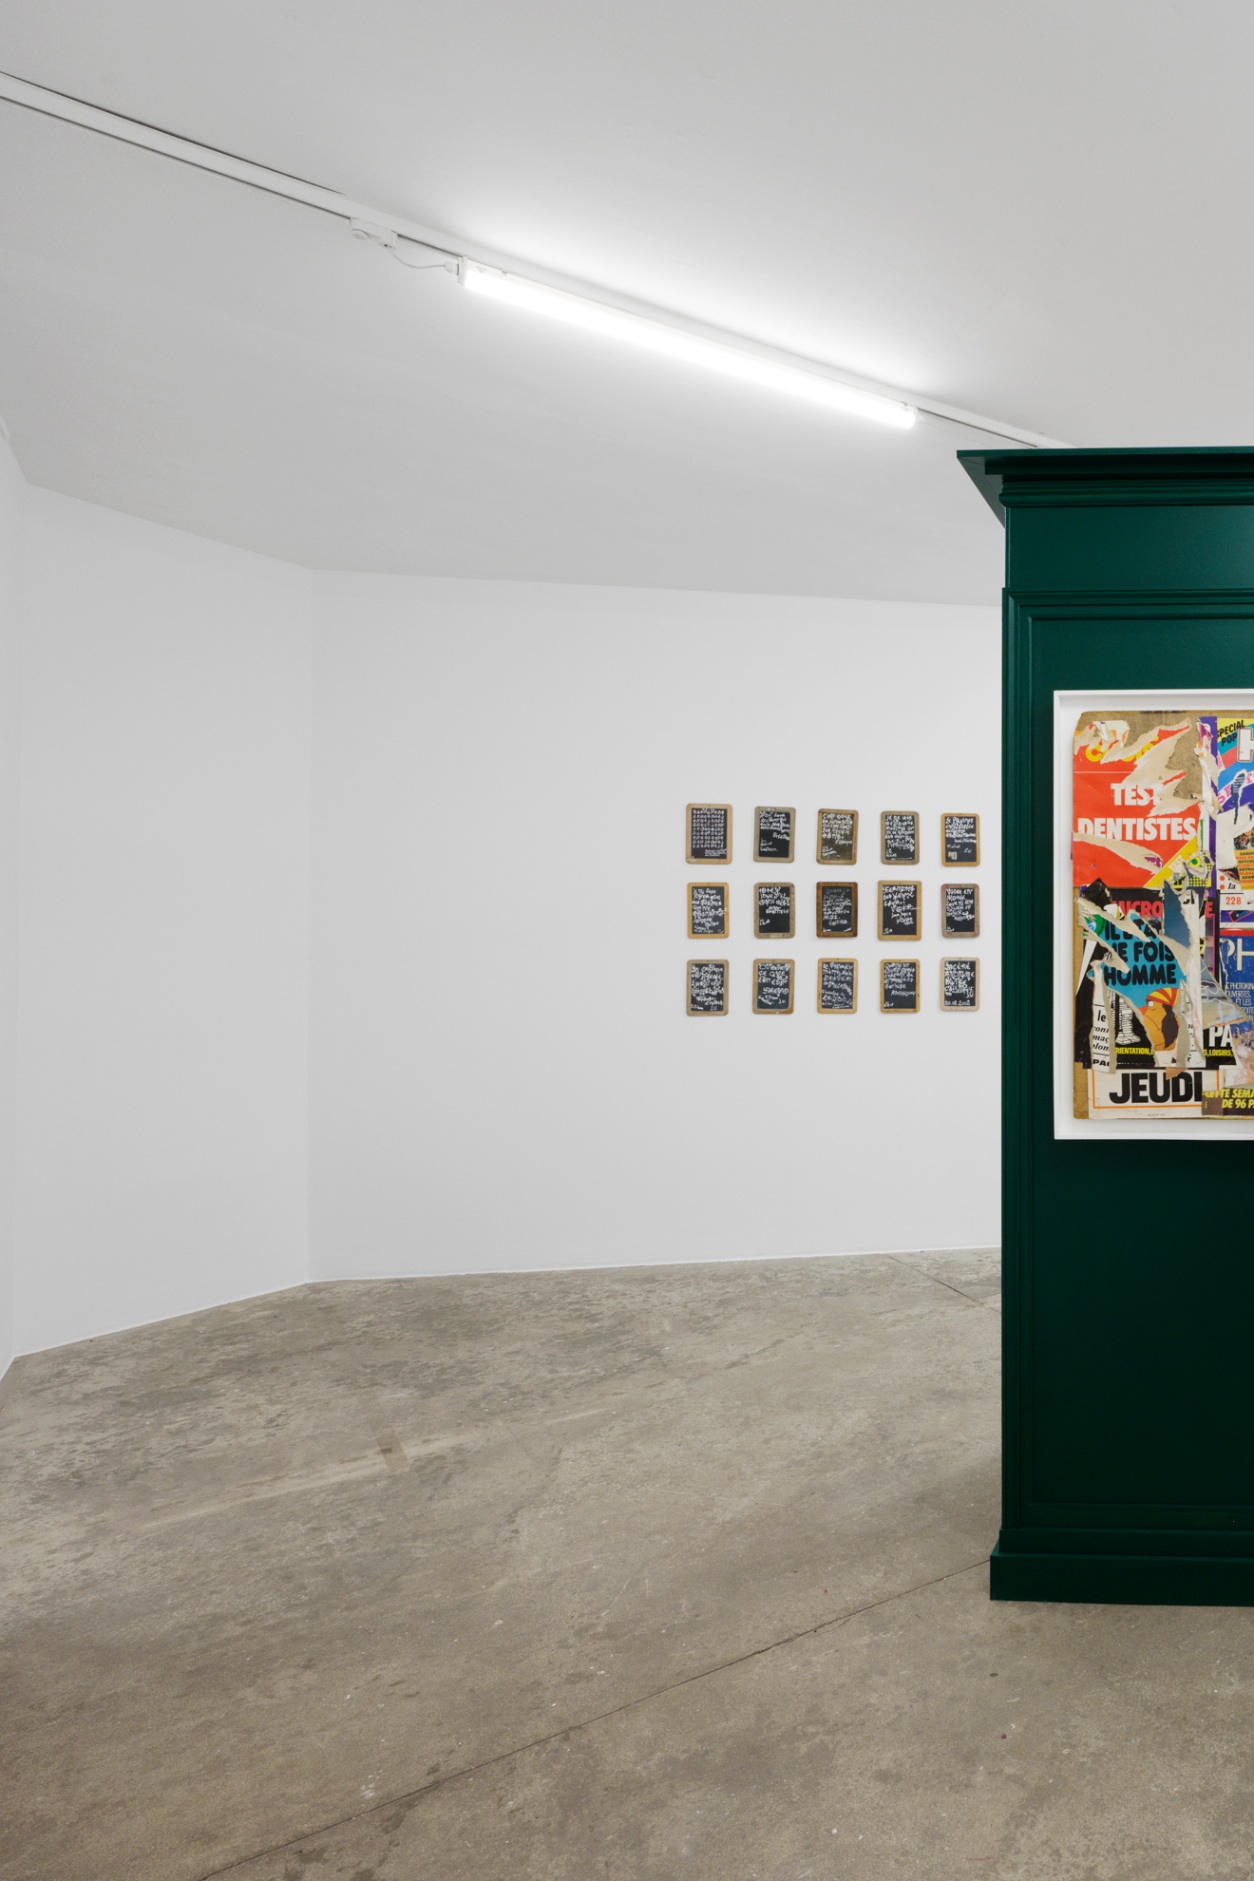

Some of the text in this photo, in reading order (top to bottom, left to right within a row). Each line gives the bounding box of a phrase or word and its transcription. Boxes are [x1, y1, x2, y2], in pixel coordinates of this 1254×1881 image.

[1221, 732, 1238, 746] POP
[1077, 817, 1198, 841] DENTISTES
[1108, 1071, 1203, 1104] JEUDI
[1221, 1099, 1234, 1109] DE
[1235, 1099, 1247, 1109] 96
